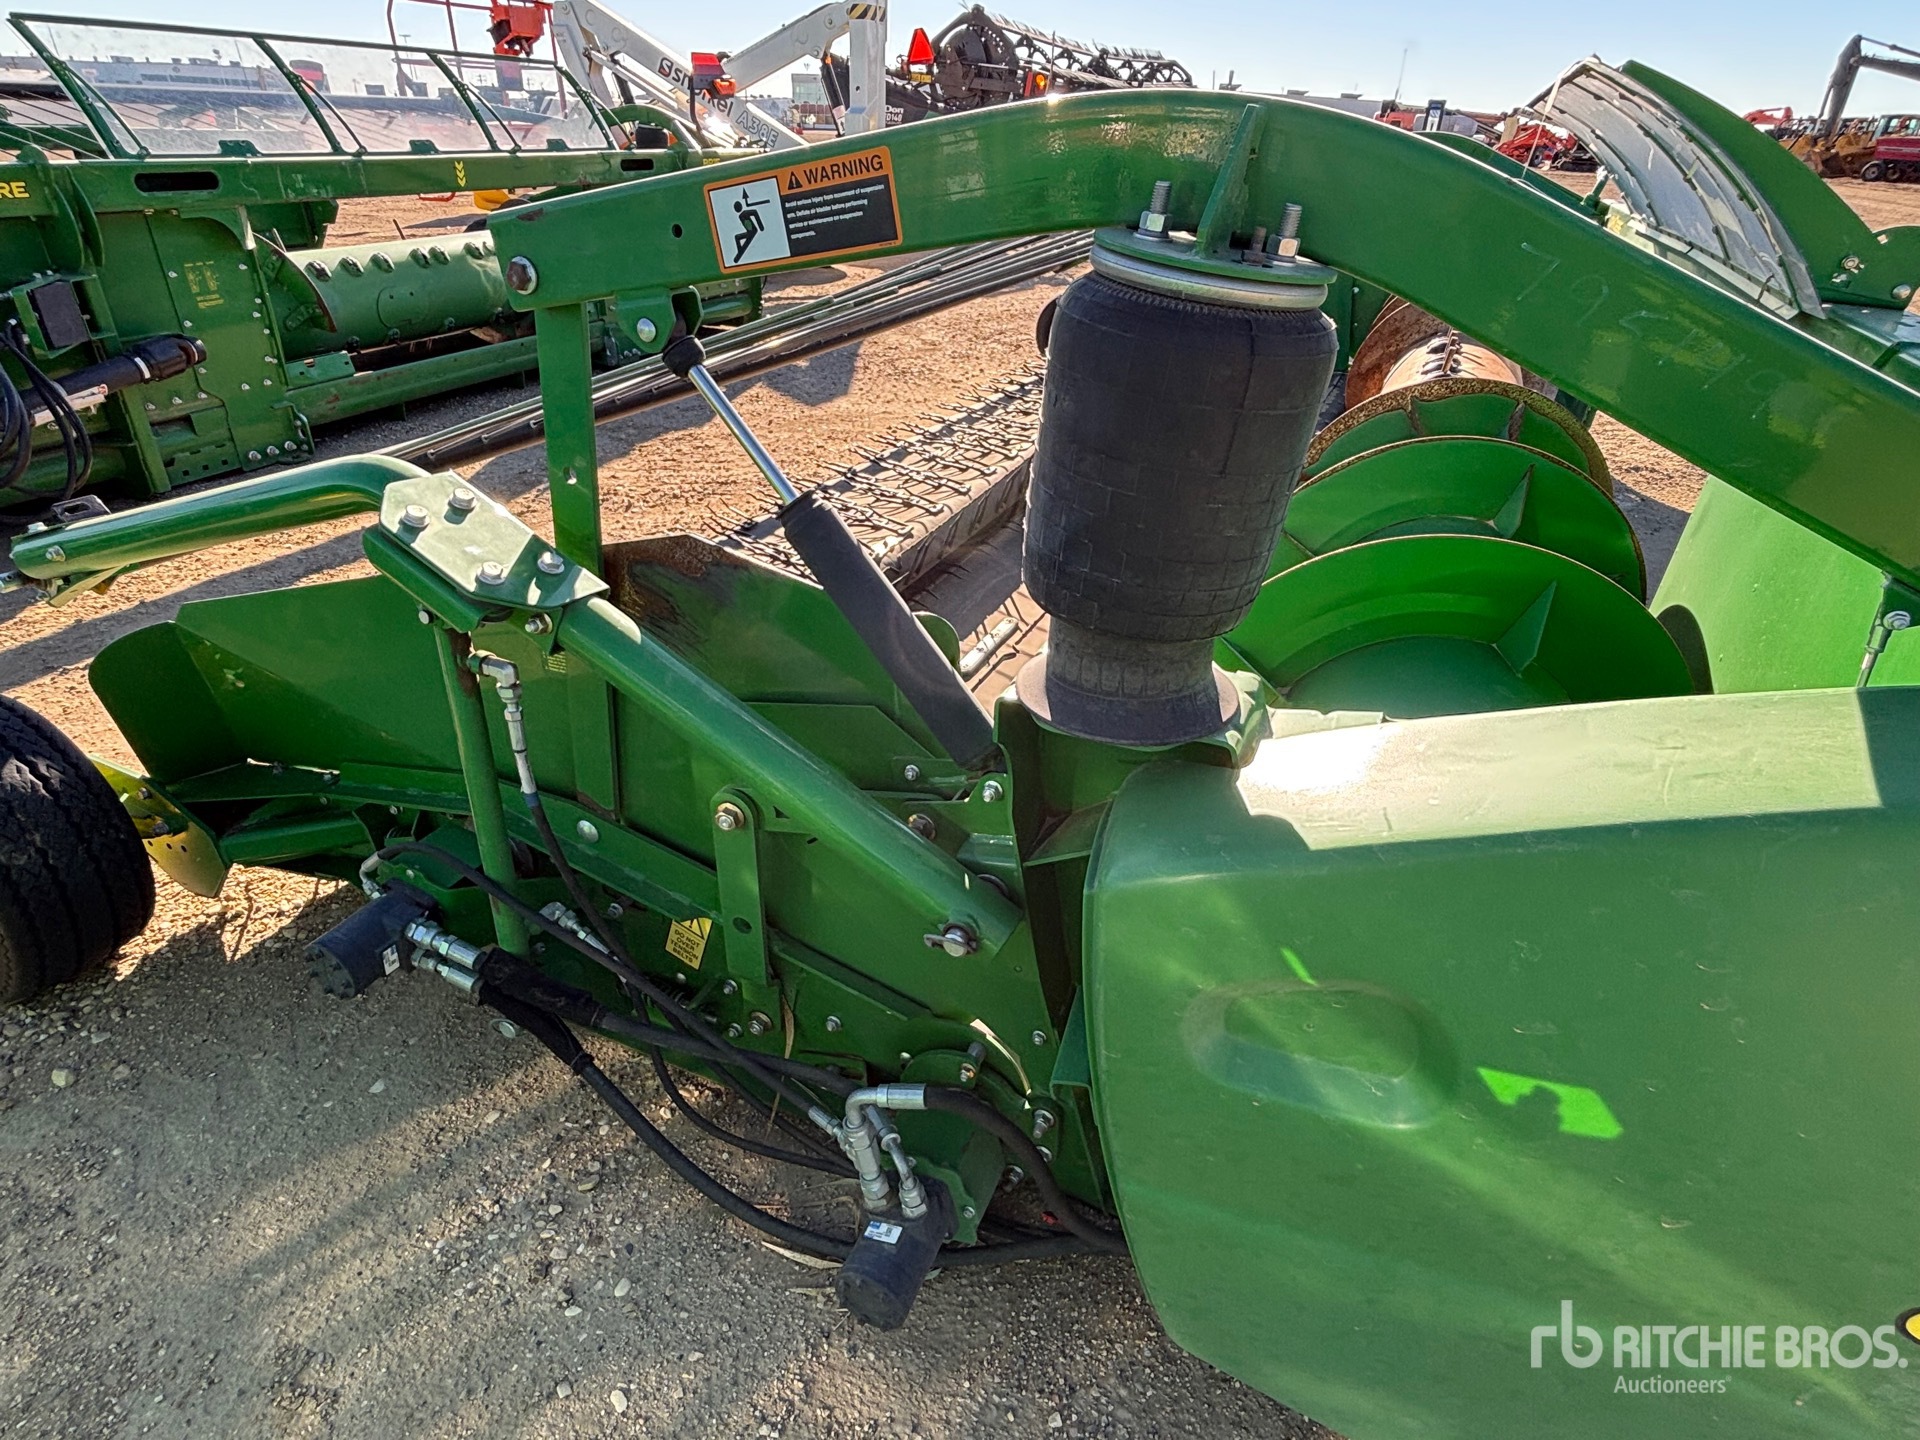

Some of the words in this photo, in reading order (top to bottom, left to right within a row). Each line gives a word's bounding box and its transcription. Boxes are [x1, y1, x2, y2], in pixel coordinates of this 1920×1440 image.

[736, 110, 779, 148] A38E
[803, 154, 884, 185] WARNING
[0, 181, 30, 199] RE
[675, 930, 685, 938] DO
[686, 937, 700, 948] NOT
[676, 937, 695, 951] OVER
[670, 939, 699, 960] TENSION
[672, 947, 694, 963] BELTS
